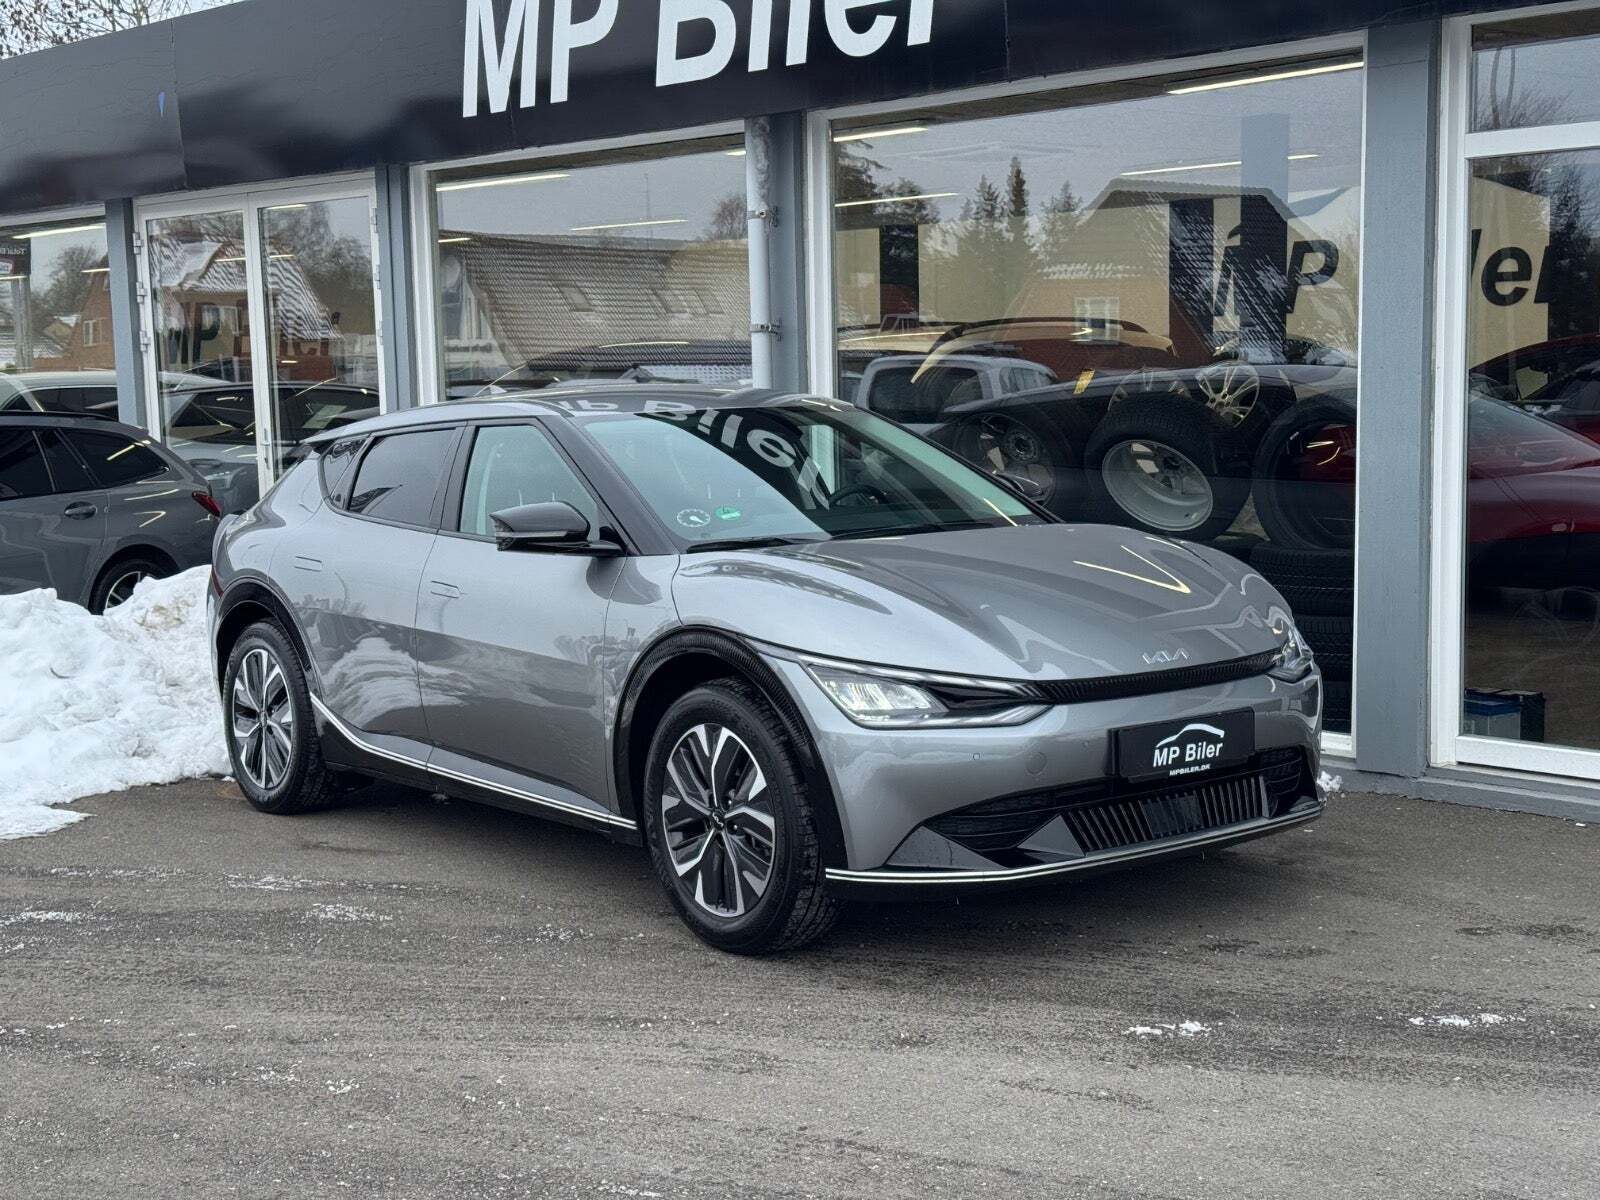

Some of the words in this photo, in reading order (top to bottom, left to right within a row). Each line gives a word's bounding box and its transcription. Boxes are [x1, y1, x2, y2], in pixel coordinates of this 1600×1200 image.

[462, 0, 619, 118] MP
[1152, 746, 1179, 768] MP
[1185, 741, 1224, 762] Biler
[1169, 763, 1211, 777] MPBILER.DK
